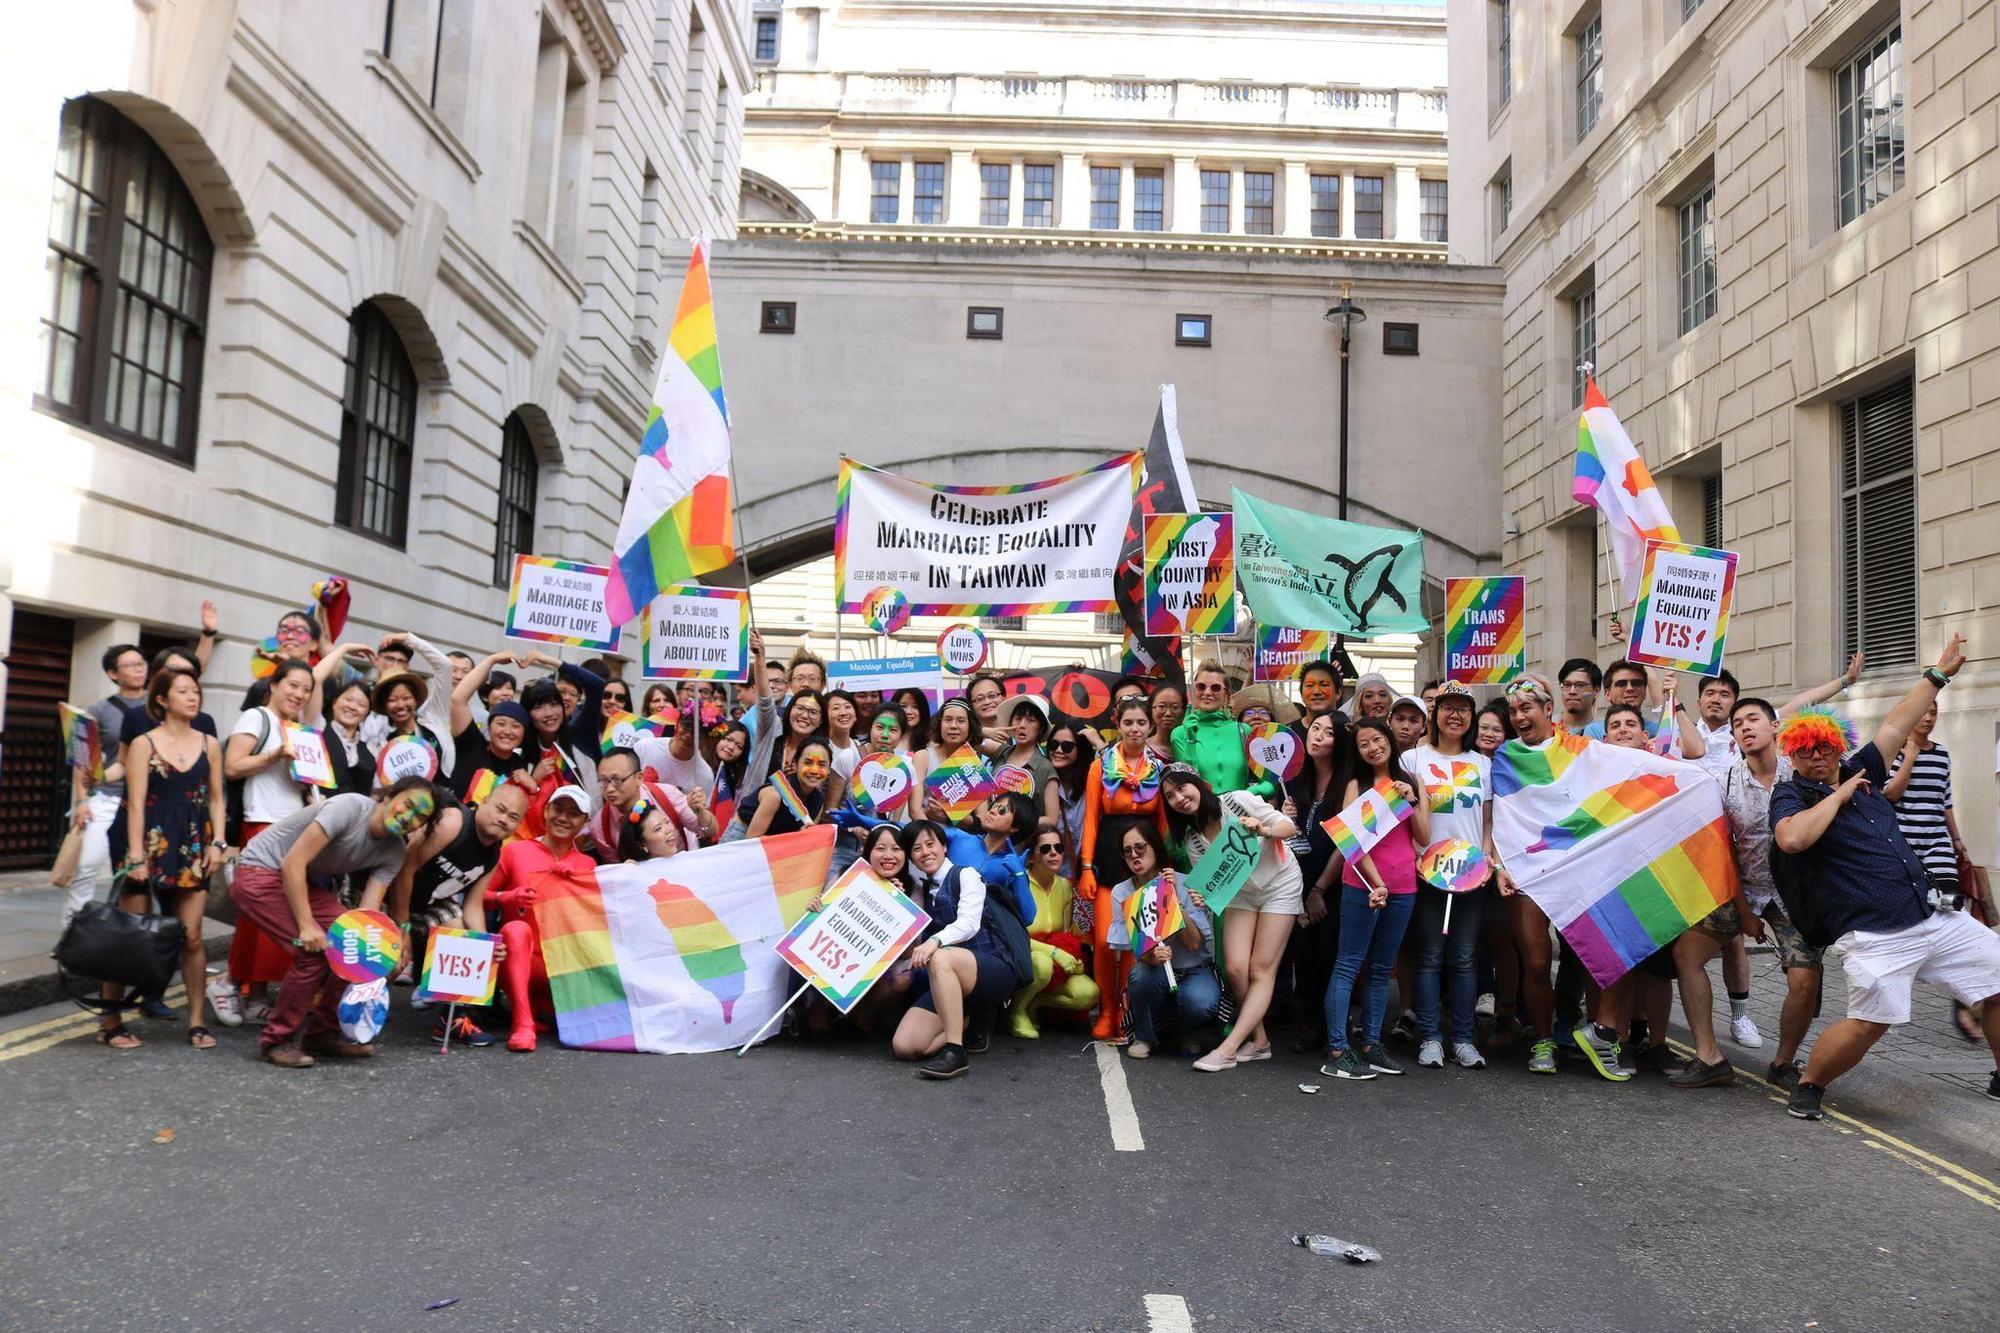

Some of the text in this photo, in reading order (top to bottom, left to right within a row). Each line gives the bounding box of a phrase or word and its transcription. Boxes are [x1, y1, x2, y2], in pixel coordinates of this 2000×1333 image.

[930, 493, 1048, 526] CELEBRATE
[877, 521, 1097, 555] MARRIAGE EQUALITY
[1168, 539, 1208, 558] FIRST
[854, 570, 920, 581] 迎接婚姻平權
[928, 563, 1046, 588] IN TAIWAN
[1153, 564, 1222, 583] COUNTRY
[543, 576, 592, 592] 愛人愛結婚
[1656, 579, 1717, 602] MARRIAGE
[527, 587, 602, 613] MARRIAGE IS
[1163, 591, 1218, 609] IN ASIA
[672, 604, 718, 618] 愛人愛結婚
[1464, 608, 1505, 624] TRANS
[1656, 599, 1710, 621] EQUALITY
[528, 611, 597, 633] ABOUT LOVE
[660, 620, 729, 640] MARRIAGE IS
[951, 636, 972, 648] LOVE
[1278, 628, 1301, 643] ARE
[1471, 630, 1496, 646] ARE
[664, 646, 727, 663] ABOUT LOVE
[950, 651, 974, 662] WINS
[1452, 653, 1519, 669] BEAUTIFUL
[849, 660, 914, 671] Marriage Equality
[389, 749, 416, 767] LOVE
[838, 897, 892, 946] MARRIAGE
[365, 924, 383, 963] JOLLY
[827, 913, 876, 958] EQUALITY
[343, 928, 360, 964] GOOD
